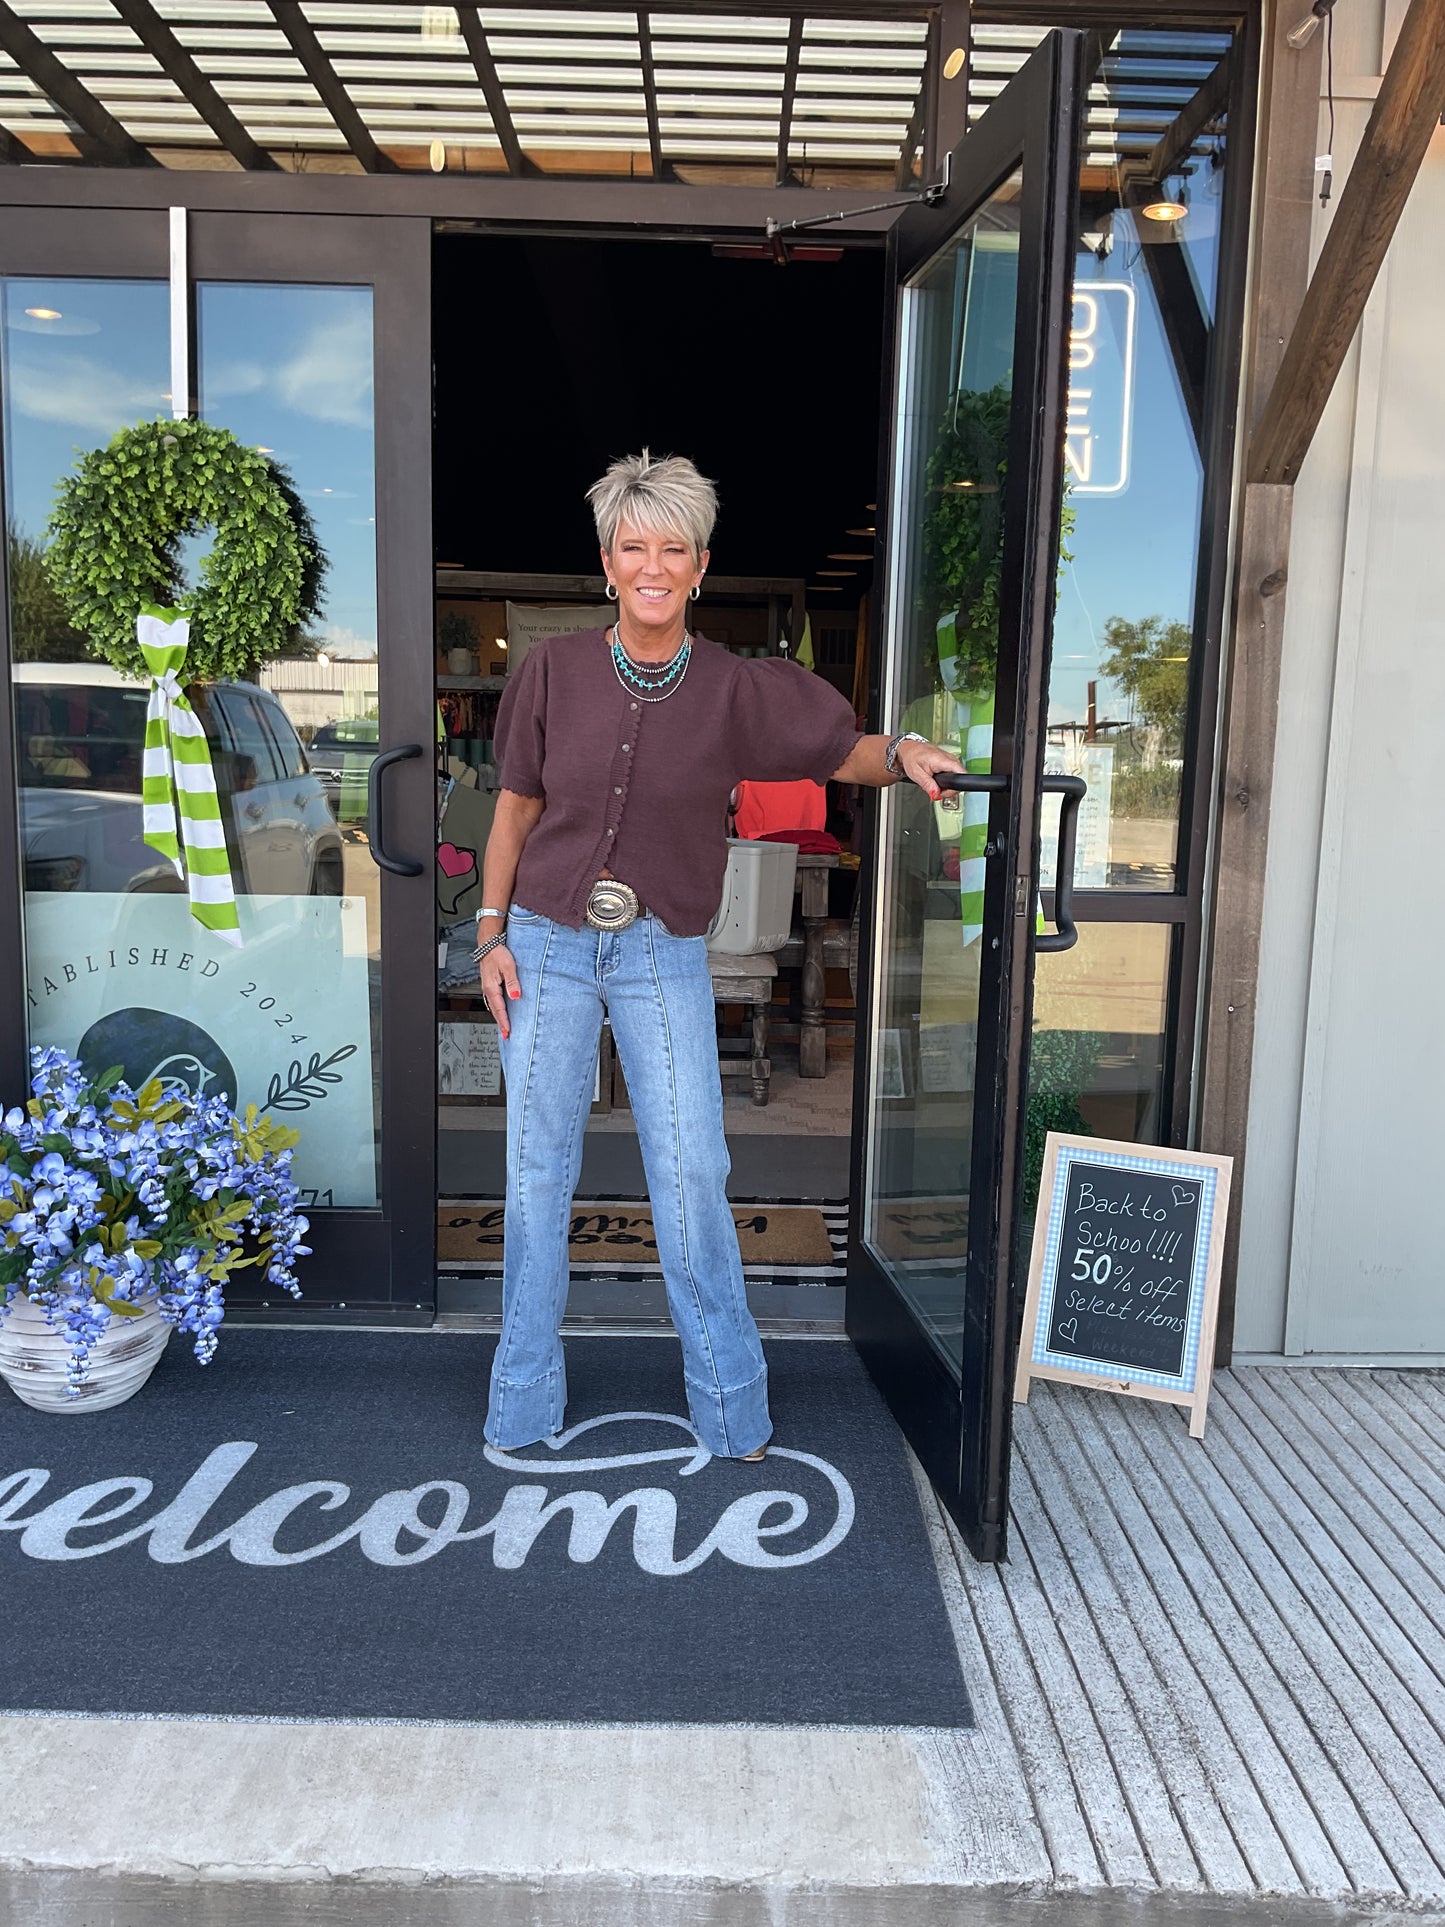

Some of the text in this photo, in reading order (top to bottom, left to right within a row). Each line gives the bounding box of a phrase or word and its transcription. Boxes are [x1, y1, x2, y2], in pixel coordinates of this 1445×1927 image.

[518, 623, 538, 632] Your
[539, 625, 561, 634] crazy
[564, 624, 572, 632] is
[240, 982, 308, 1045] 2024
[1074, 1182, 1167, 1222] Back to
[1076, 1221, 1183, 1264] School!!!
[1070, 1248, 1184, 1302] 50% off
[1135, 1304, 1187, 1333] items
